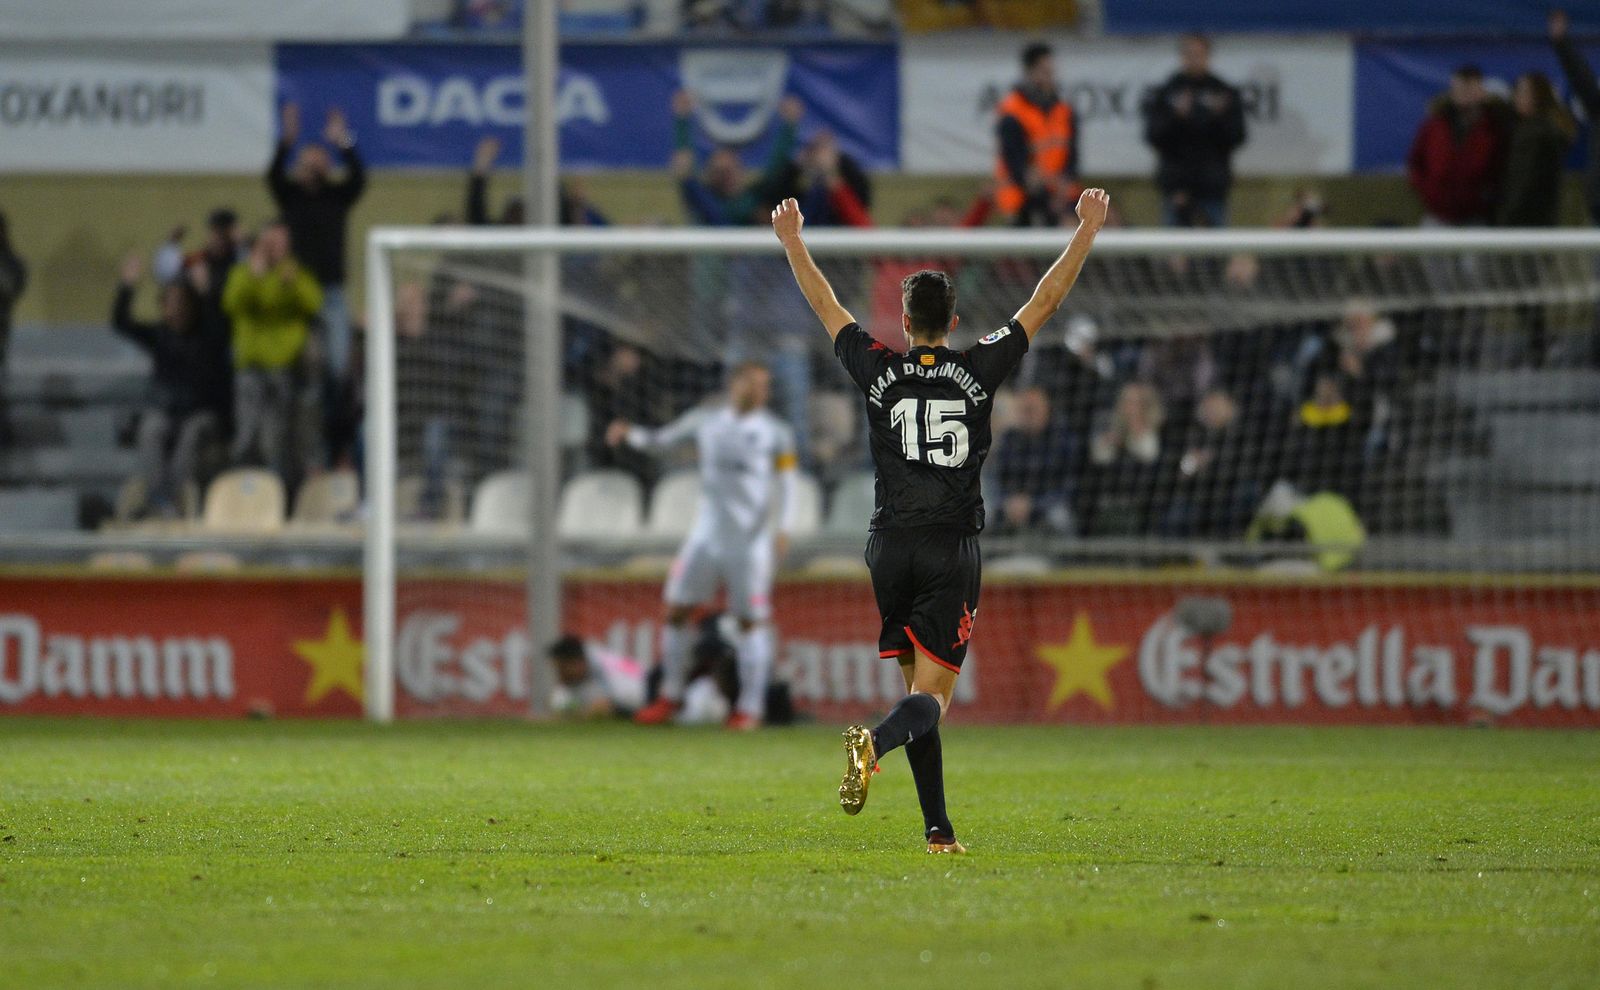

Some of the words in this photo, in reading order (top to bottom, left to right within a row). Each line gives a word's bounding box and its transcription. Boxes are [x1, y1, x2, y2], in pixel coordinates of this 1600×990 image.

[378, 76, 609, 127] DACA
[869, 367, 896, 408] JUAN
[891, 398, 970, 468] 15
[1139, 611, 1456, 709] Estrella
[1466, 625, 1600, 713] Da
